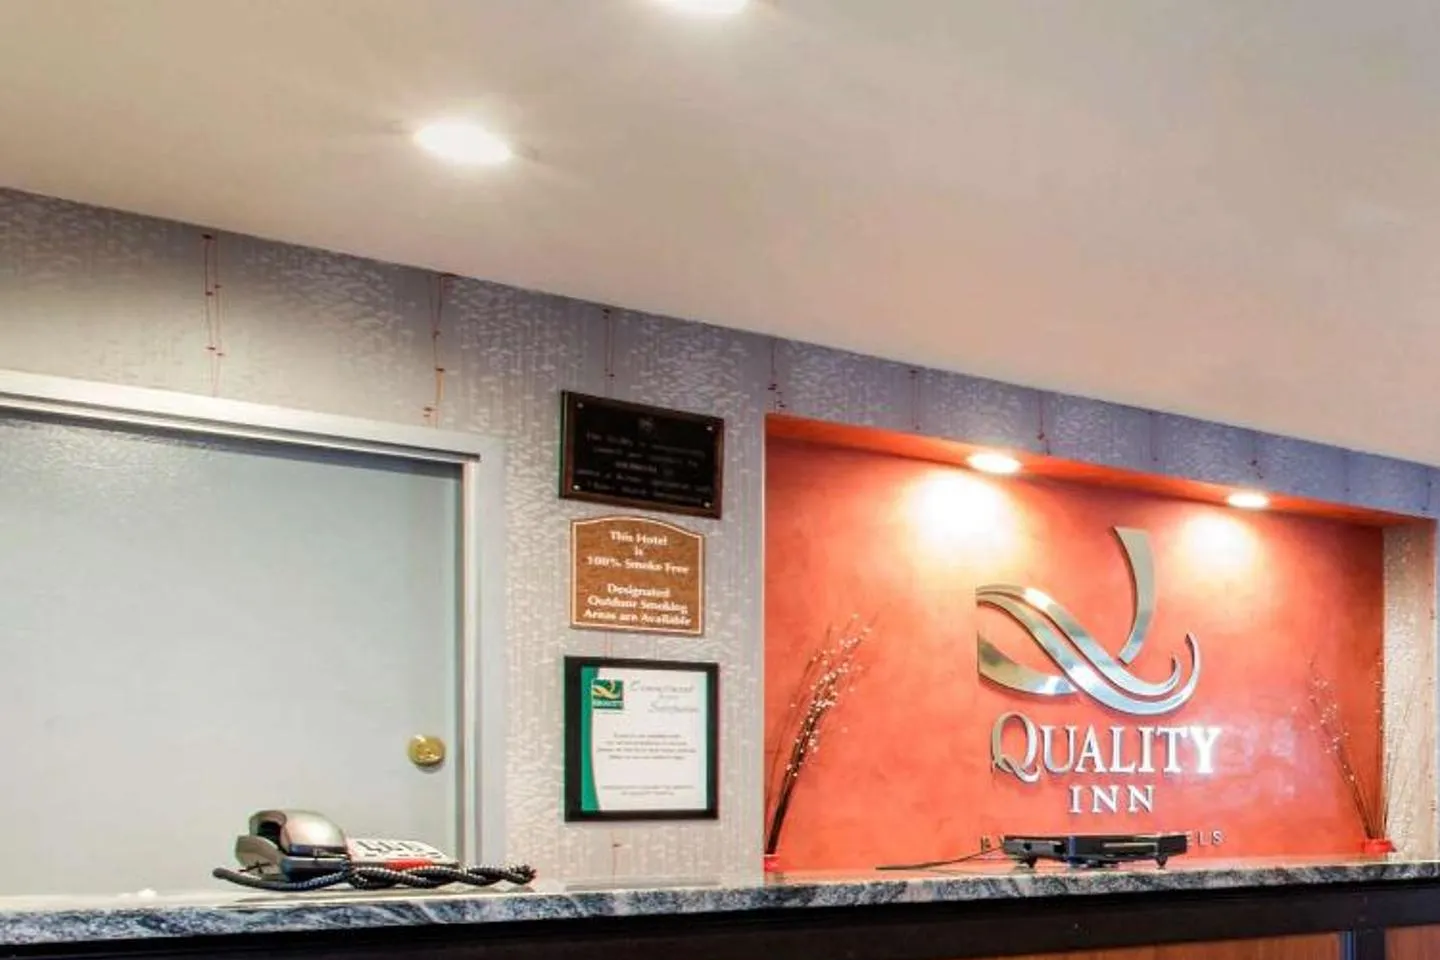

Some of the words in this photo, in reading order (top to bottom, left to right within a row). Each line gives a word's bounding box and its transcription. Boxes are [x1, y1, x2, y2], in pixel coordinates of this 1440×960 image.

[610, 530, 633, 543] This
[636, 533, 668, 546] Hotel
[587, 555, 622, 569] 100%
[624, 559, 663, 572] Smoke
[664, 562, 690, 574] Free
[607, 583, 670, 599] Designated
[587, 595, 638, 609] Outdoor
[640, 600, 688, 614] Smoking
[583, 607, 618, 620] Areas
[641, 614, 692, 626] Available
[991, 711, 1222, 783] QUALITY
[1068, 784, 1156, 814] INN
